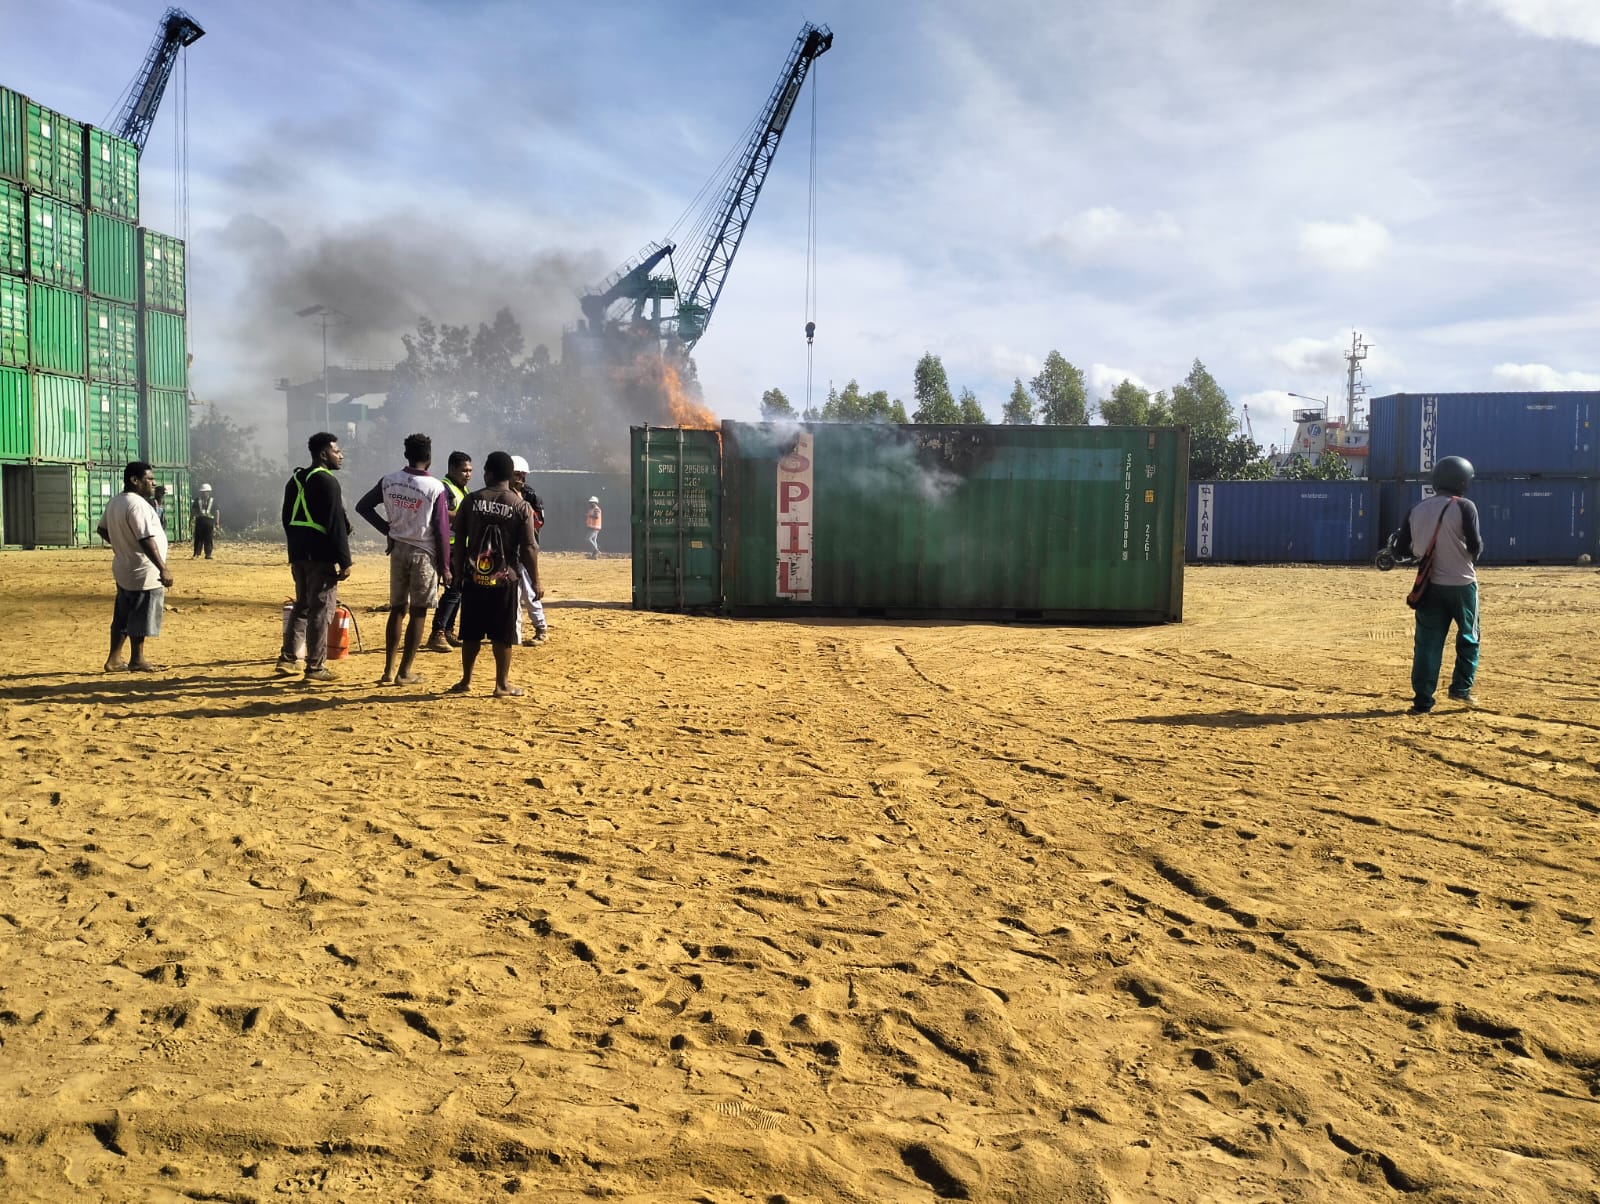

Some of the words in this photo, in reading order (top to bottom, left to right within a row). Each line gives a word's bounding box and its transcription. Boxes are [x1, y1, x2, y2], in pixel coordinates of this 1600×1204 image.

[472, 499, 513, 518] MAJESTIC
[780, 441, 810, 594] SPIL
[1200, 499, 1210, 555] TANTO
